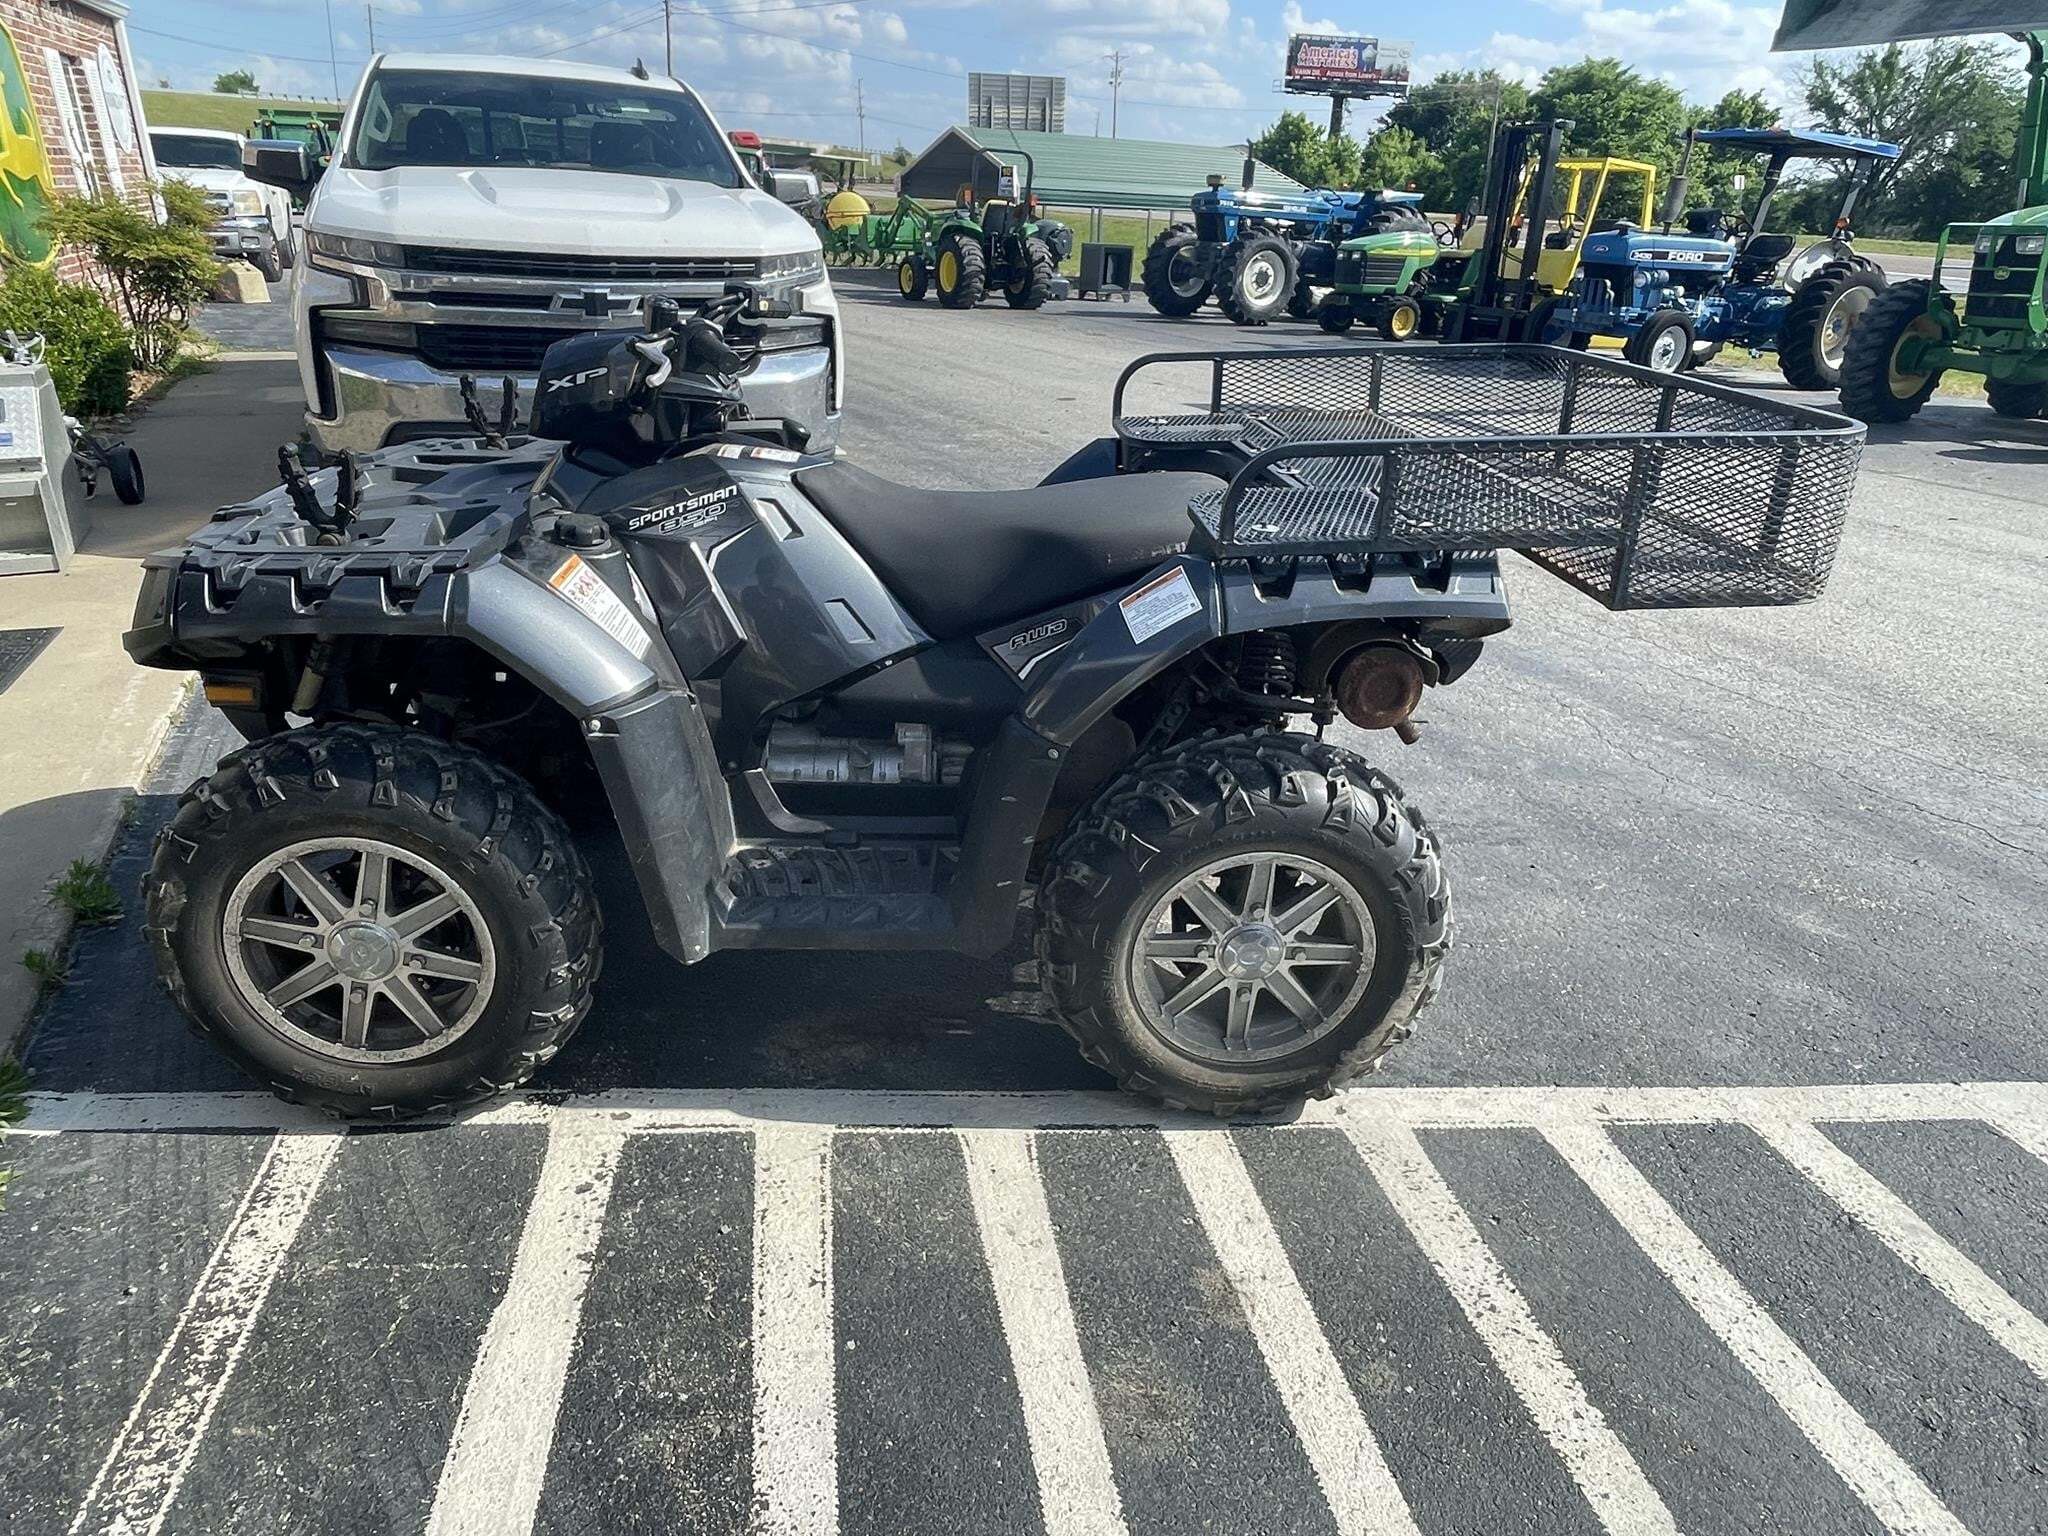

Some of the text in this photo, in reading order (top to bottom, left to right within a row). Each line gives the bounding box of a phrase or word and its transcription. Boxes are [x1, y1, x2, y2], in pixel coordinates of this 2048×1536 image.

[1297, 56, 1357, 68] MATTRESS
[1298, 42, 1358, 60] America's
[1667, 251, 1704, 261] FORD
[547, 366, 608, 392] XP
[629, 485, 737, 530] SPORTSMAN
[1009, 618, 1068, 650] AWD
